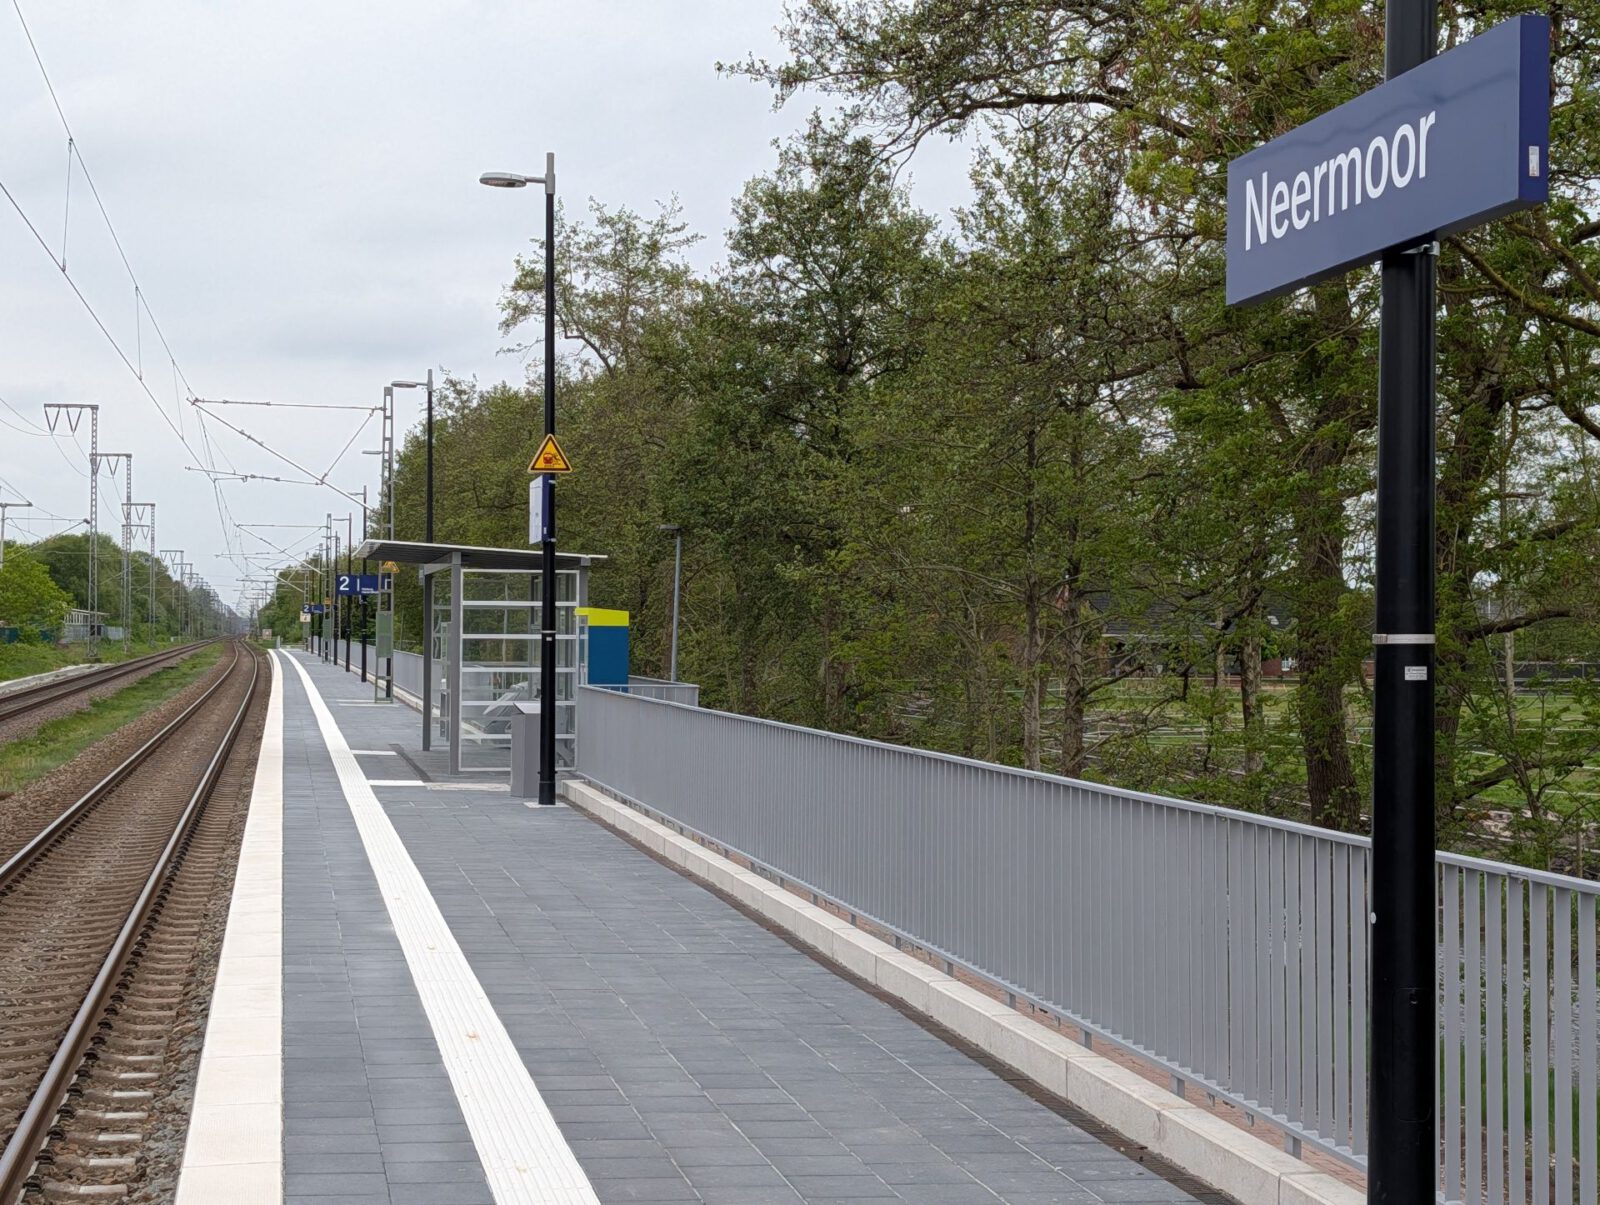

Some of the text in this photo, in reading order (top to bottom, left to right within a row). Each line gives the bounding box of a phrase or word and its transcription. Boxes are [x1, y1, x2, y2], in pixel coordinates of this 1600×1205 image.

[1245, 110, 1436, 251] Neermoor
[339, 575, 350, 591] 2
[303, 604, 310, 612] 2
